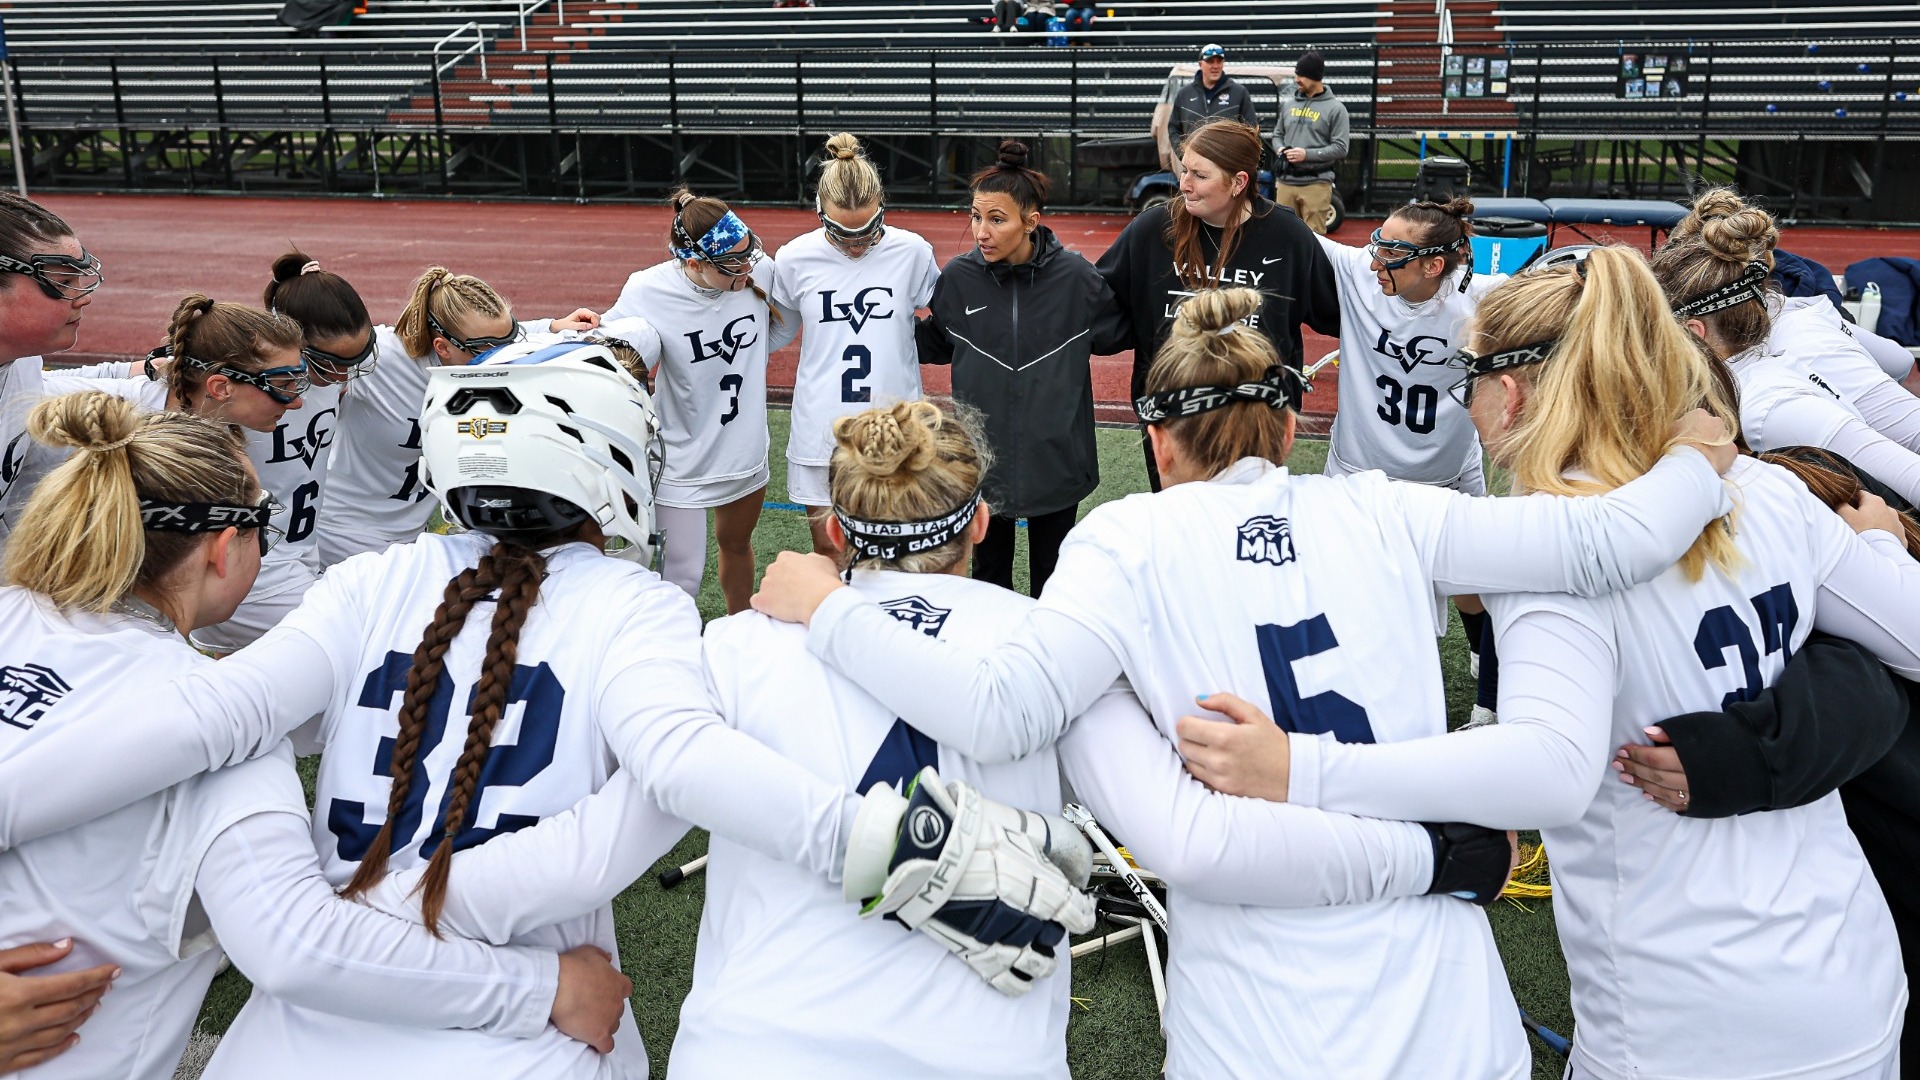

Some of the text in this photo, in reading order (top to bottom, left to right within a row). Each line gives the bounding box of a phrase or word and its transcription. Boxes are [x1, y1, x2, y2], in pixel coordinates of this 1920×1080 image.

[1418, 244, 1445, 255] STX
[1490, 242, 1502, 276] RADE
[818, 286, 895, 335] LVC
[683, 313, 759, 366] LVC
[1372, 326, 1449, 375] LVC
[183, 355, 209, 371] TX
[841, 344, 872, 403] 2
[1492, 346, 1544, 369] STX
[218, 367, 258, 386] STX
[450, 371, 510, 379] cascade
[718, 373, 744, 427] 3
[1236, 382, 1290, 409] STX
[1375, 373, 1439, 435] 30
[264, 407, 337, 472] LVC
[140, 505, 187, 524] TX
[207, 506, 261, 523] STX
[285, 479, 320, 544] 6
[908, 530, 950, 552] GAIT
[1255, 612, 1378, 745] 5
[327, 649, 566, 863] 32
[1125, 872, 1149, 902] STX
[1145, 900, 1168, 928] FORTRE
